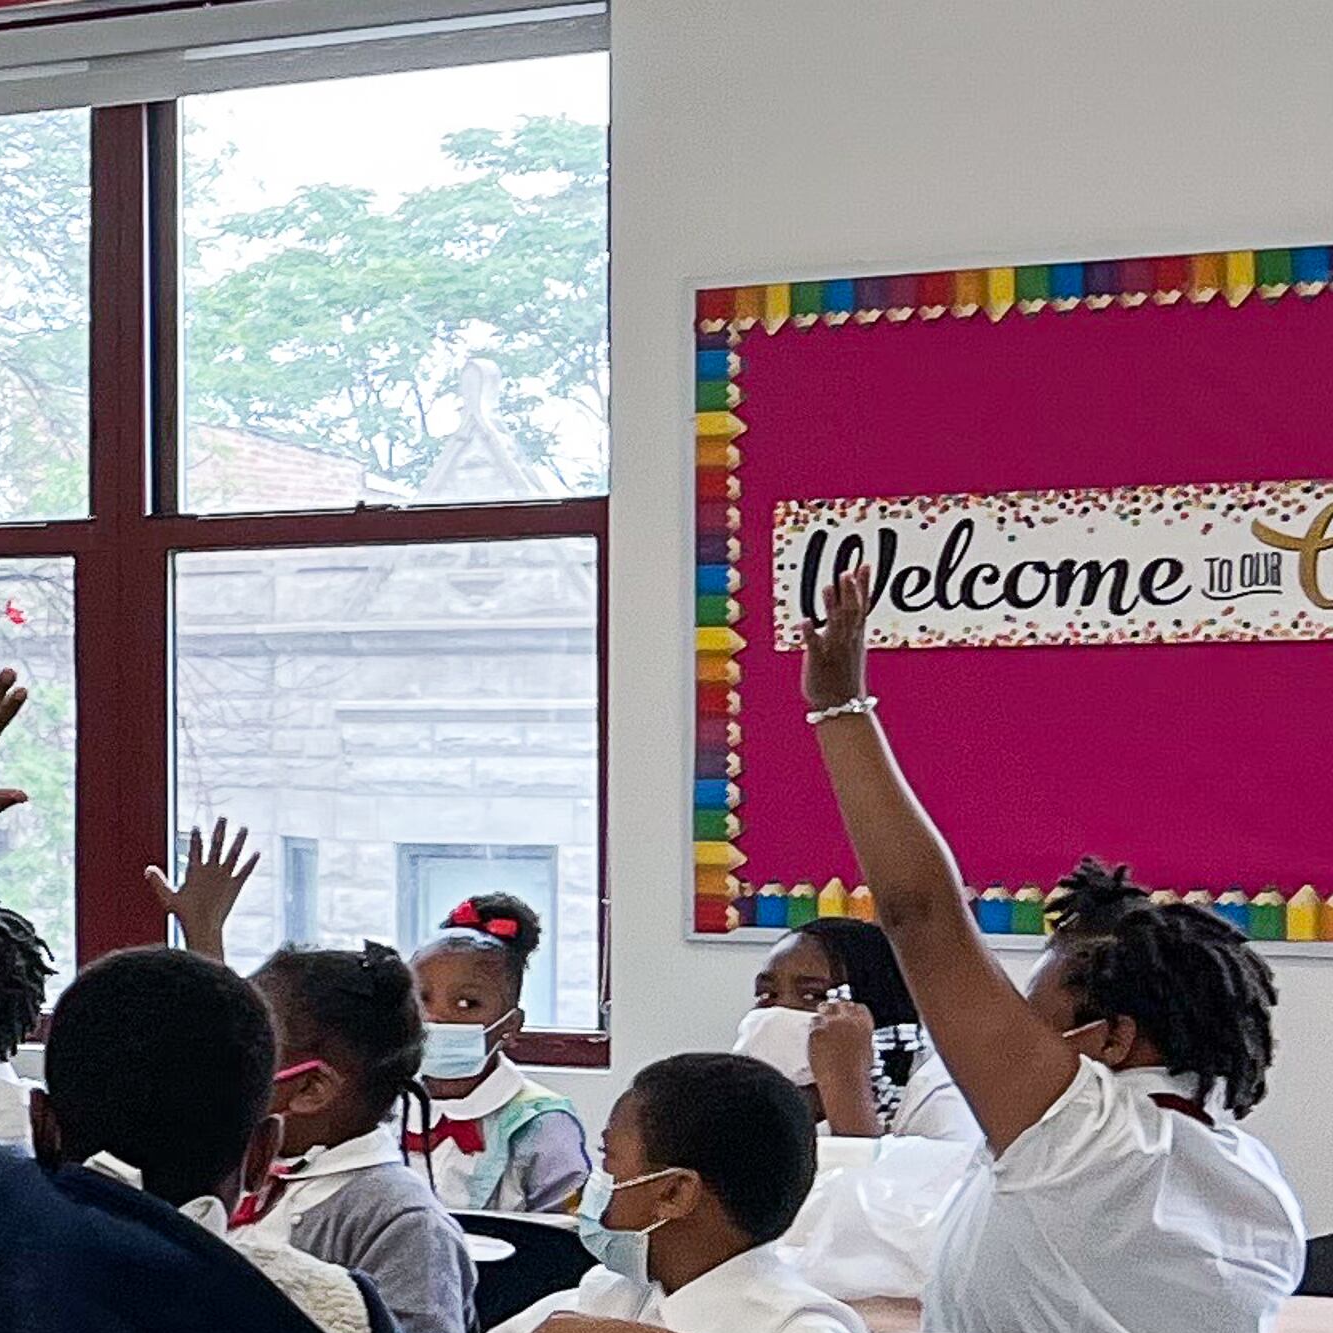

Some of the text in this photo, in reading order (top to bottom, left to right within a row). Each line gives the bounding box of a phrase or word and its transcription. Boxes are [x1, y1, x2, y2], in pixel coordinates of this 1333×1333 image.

[799, 517, 1282, 630] Welcome TO OUR
